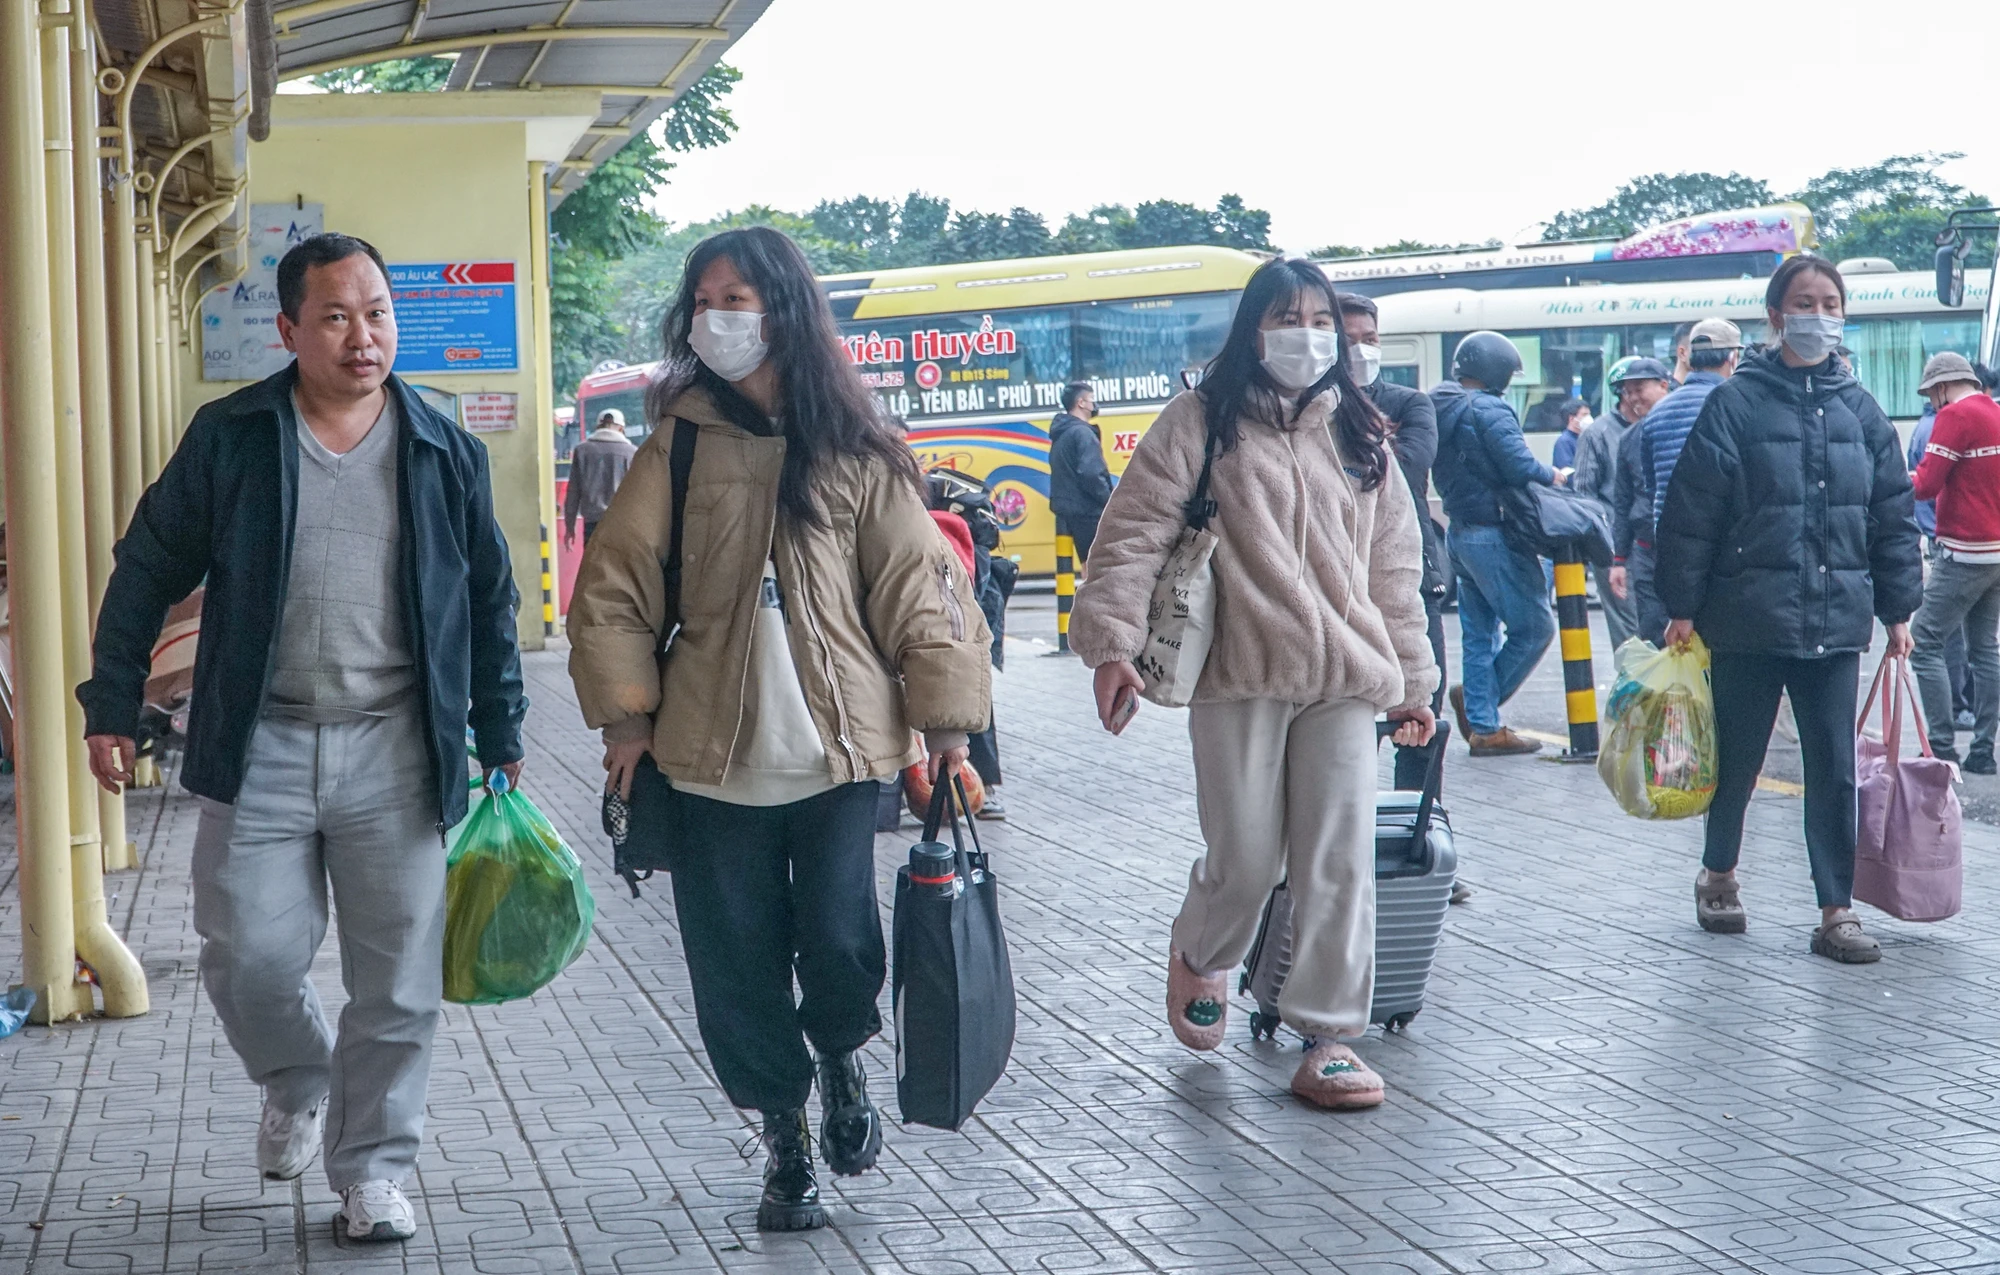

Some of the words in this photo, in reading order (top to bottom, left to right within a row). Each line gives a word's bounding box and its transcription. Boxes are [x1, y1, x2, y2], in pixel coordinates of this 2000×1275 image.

[1664, 295, 1714, 309] Loan
[1901, 285, 1937, 299] Cùn
[260, 317, 276, 325] 900
[912, 314, 1016, 365] Huyền
[920, 387, 952, 414] YÊN
[957, 383, 984, 411] BÁI
[998, 380, 1031, 409] PHÚ
[1124, 370, 1170, 400] PHÚC
[1113, 431, 1139, 452] XE
[1156, 636, 1182, 650] MAKE
